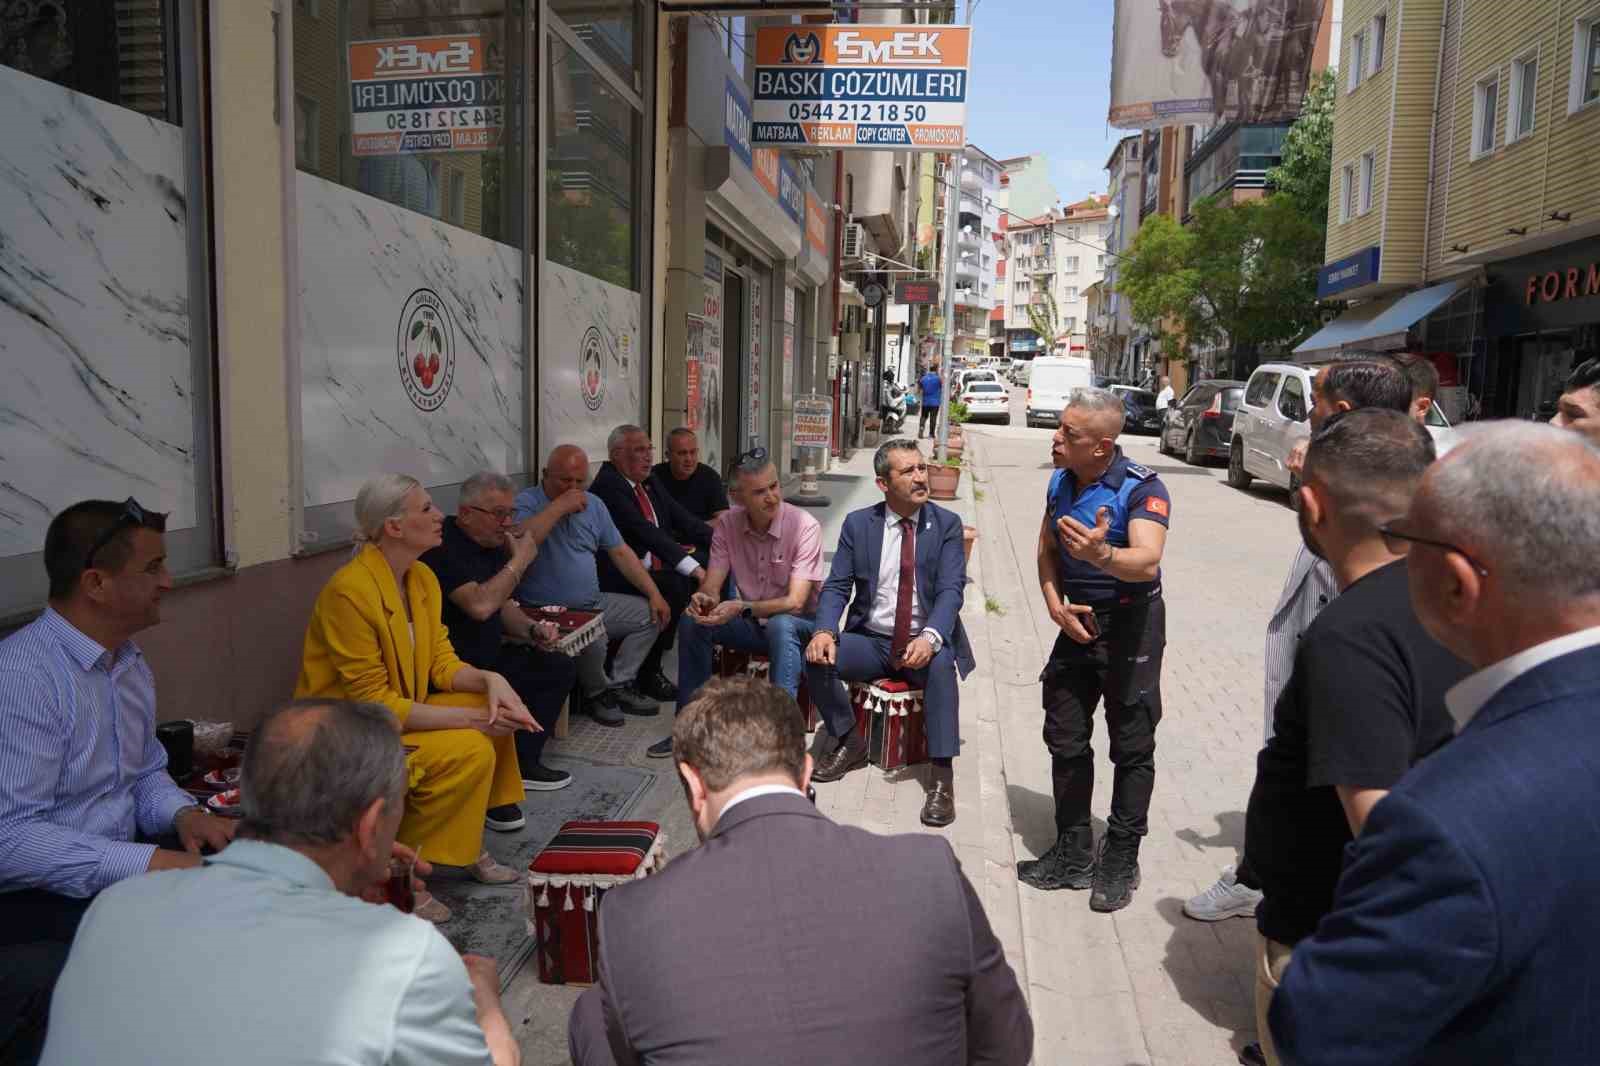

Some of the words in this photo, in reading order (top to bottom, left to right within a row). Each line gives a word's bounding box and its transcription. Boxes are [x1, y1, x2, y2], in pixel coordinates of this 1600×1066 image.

[758, 71, 824, 96] BASKI
[831, 71, 962, 98] ÇÖZÜMLERİ
[789, 103, 833, 121] 0544
[838, 104, 871, 121] 212
[878, 104, 898, 121] 18
[904, 105, 926, 122] 50
[756, 126, 799, 140] MATBAA
[810, 127, 852, 141] REKLAM
[857, 127, 878, 141] COPY
[878, 127, 906, 142] CENTER
[914, 128, 961, 143] PROMOSYON
